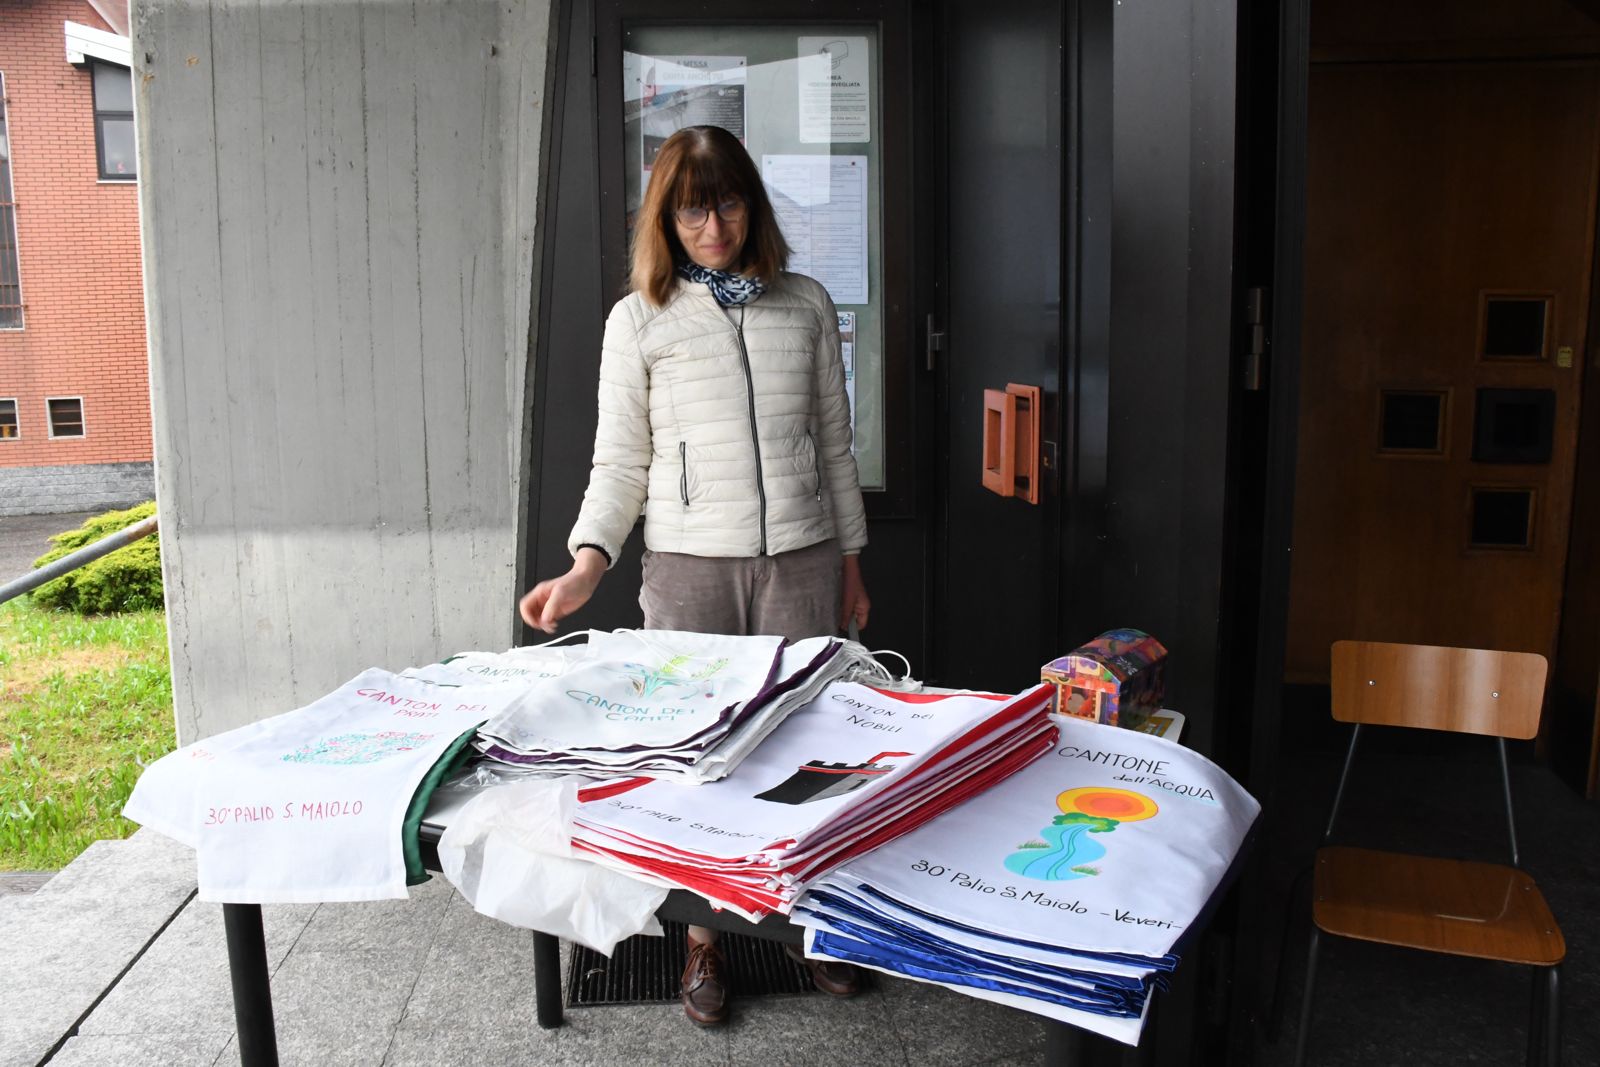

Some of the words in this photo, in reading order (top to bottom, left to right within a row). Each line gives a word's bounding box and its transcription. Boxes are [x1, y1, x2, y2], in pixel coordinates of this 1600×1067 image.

[356, 688, 442, 711] CANTON
[455, 703, 488, 712] DEI
[565, 689, 650, 715] CANTON
[831, 693, 897, 718] CANTON
[845, 713, 904, 734] NOBILI
[1058, 746, 1171, 777] CANTONE
[1112, 773, 1216, 801] dell'ACQUA
[234, 806, 275, 823] PALIO
[282, 801, 294, 819] S.
[301, 800, 364, 821] MAIOLO
[949, 871, 996, 895] Palio
[999, 885, 1018, 900] S.
[1020, 889, 1089, 915] Maiolo
